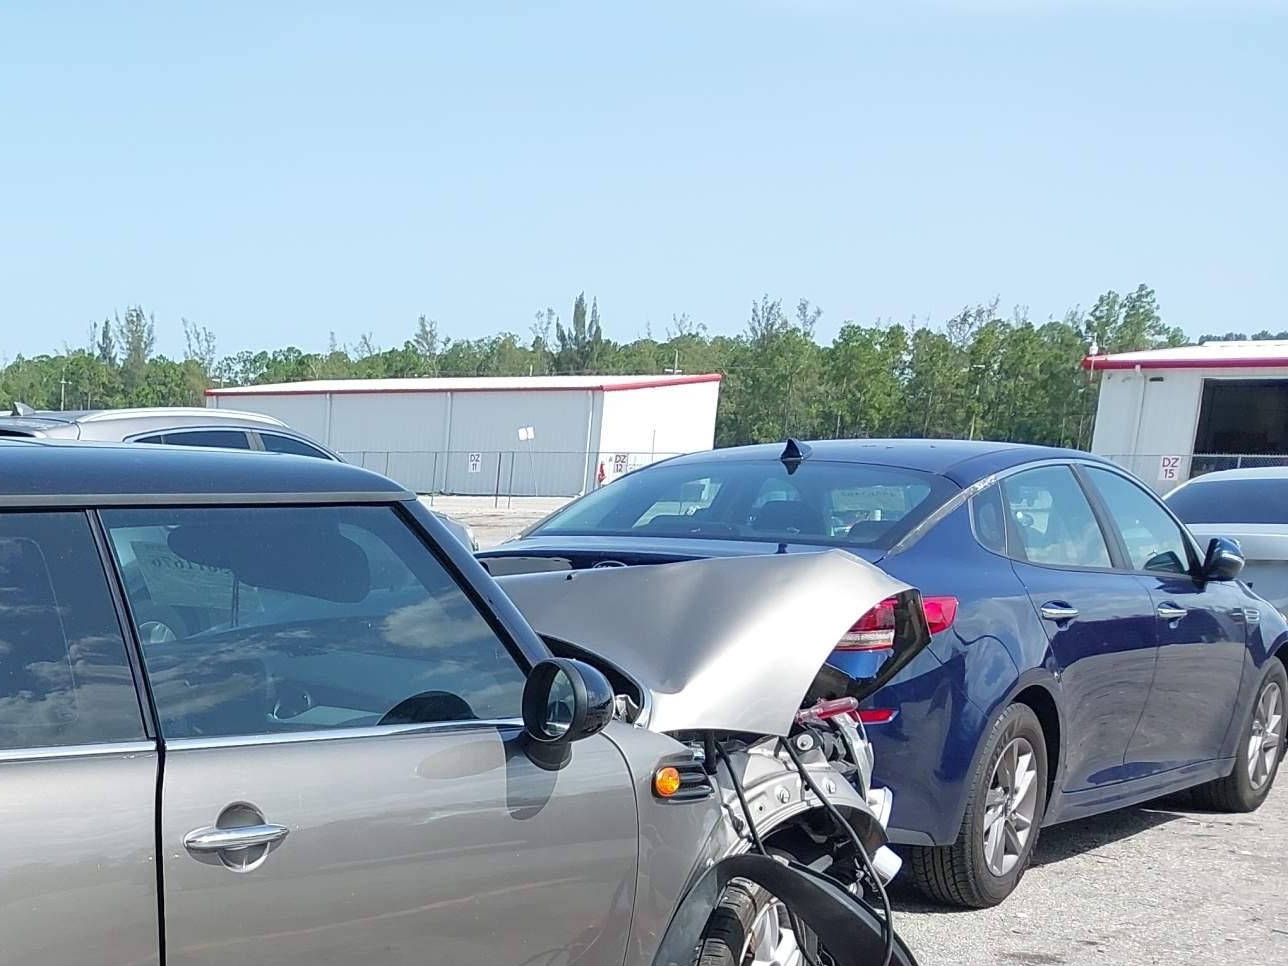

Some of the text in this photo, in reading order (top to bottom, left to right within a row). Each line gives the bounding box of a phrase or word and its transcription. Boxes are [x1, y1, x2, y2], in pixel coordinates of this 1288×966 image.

[469, 454, 480, 463] DZ
[614, 454, 627, 464] DZ
[1162, 457, 1180, 468] DZ
[615, 463, 623, 473] 12
[1164, 468, 1175, 479] 15
